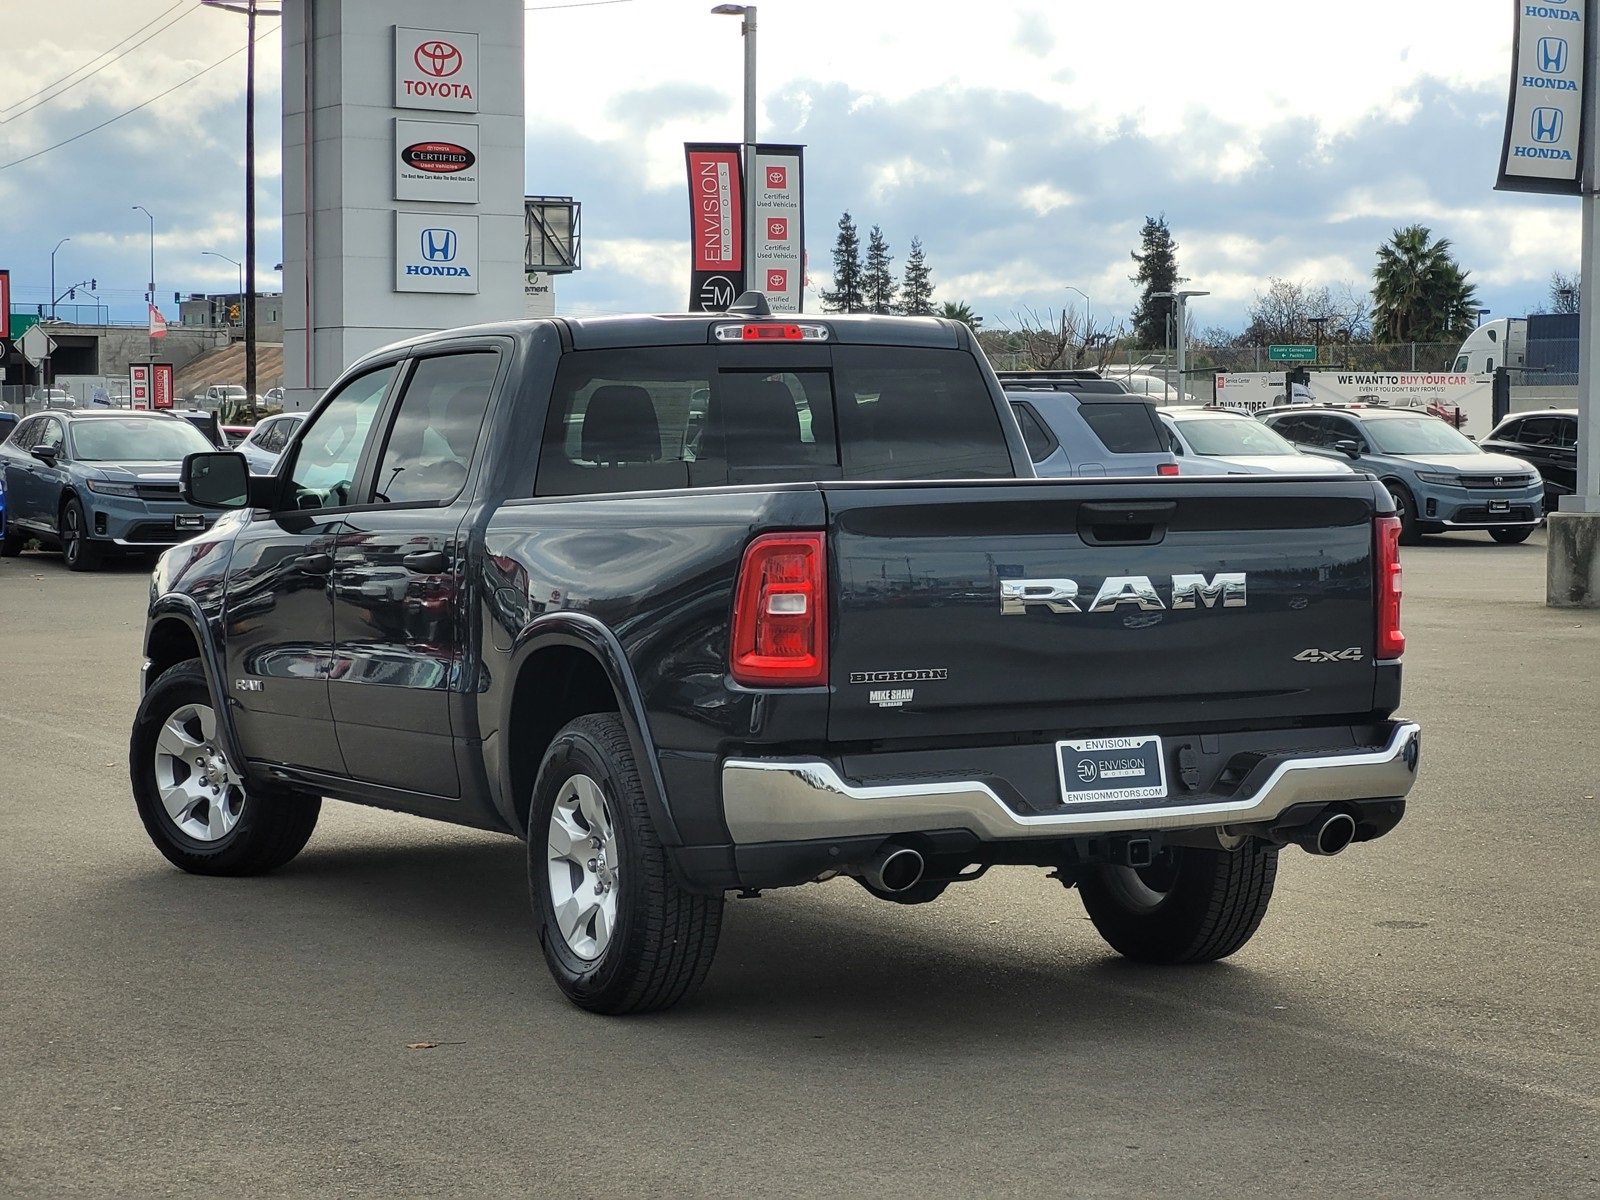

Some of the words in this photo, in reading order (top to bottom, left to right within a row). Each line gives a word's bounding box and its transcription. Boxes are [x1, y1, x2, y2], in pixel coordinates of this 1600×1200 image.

[1525, 6, 1581, 21] HONDA
[404, 81, 472, 99] TOYOTA
[1522, 76, 1578, 91] HONDA
[411, 151, 466, 162] CERTIFIED
[1514, 146, 1573, 161] HONDA
[700, 161, 720, 261] ENVISION
[720, 171, 730, 253] MOTORS
[406, 265, 471, 277] HONDA
[772, 303, 796, 311] Vehicles
[1337, 375, 1353, 384] WE
[1355, 375, 1384, 385] WANT
[1386, 375, 1399, 385] TO
[1400, 376, 1419, 385] BUY
[1421, 376, 1446, 385] YOUR
[1448, 376, 1467, 385] CAR
[1244, 401, 1267, 413] TIRES
[1000, 572, 1248, 616] RAM
[1293, 647, 1364, 663] 4x4
[850, 668, 948, 684] BIGHORN
[235, 679, 264, 692] RAM
[870, 690, 890, 701] MIKE
[891, 689, 914, 700] SHAW
[1085, 739, 1132, 750] ENVISION
[1099, 759, 1145, 771] ENVISION
[1067, 788, 1163, 802] ENVISIONMOTORS.COM
